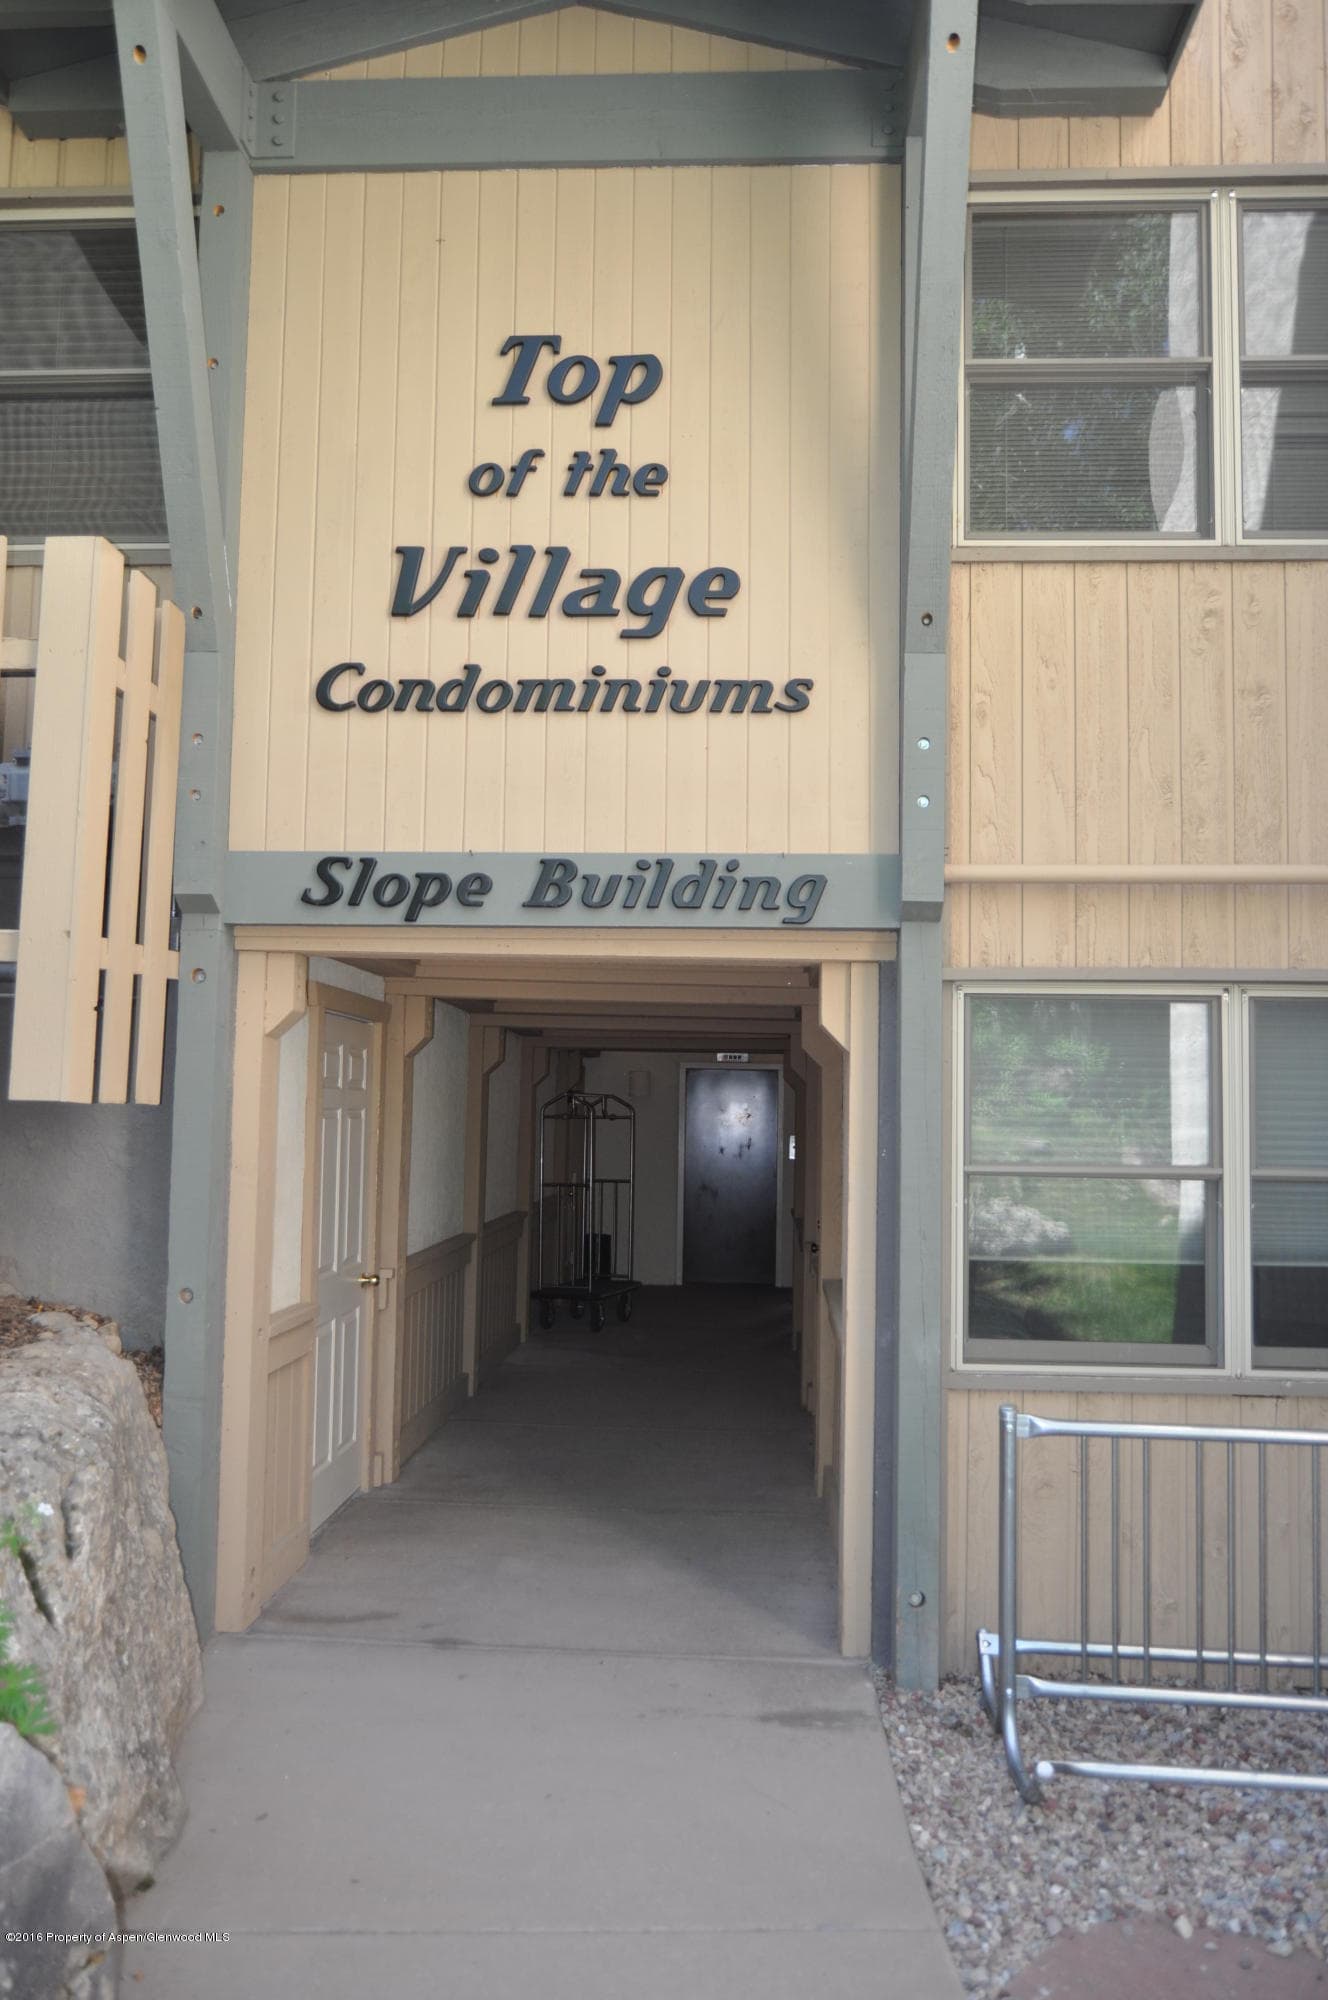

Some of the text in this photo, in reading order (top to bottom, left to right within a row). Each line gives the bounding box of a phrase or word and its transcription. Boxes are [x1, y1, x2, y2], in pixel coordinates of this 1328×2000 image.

[491, 335, 664, 427] Top
[467, 449, 669, 497] of the
[390, 545, 741, 639] Village
[315, 662, 814, 714] Condominiums
[300, 856, 828, 925] Slope Building
